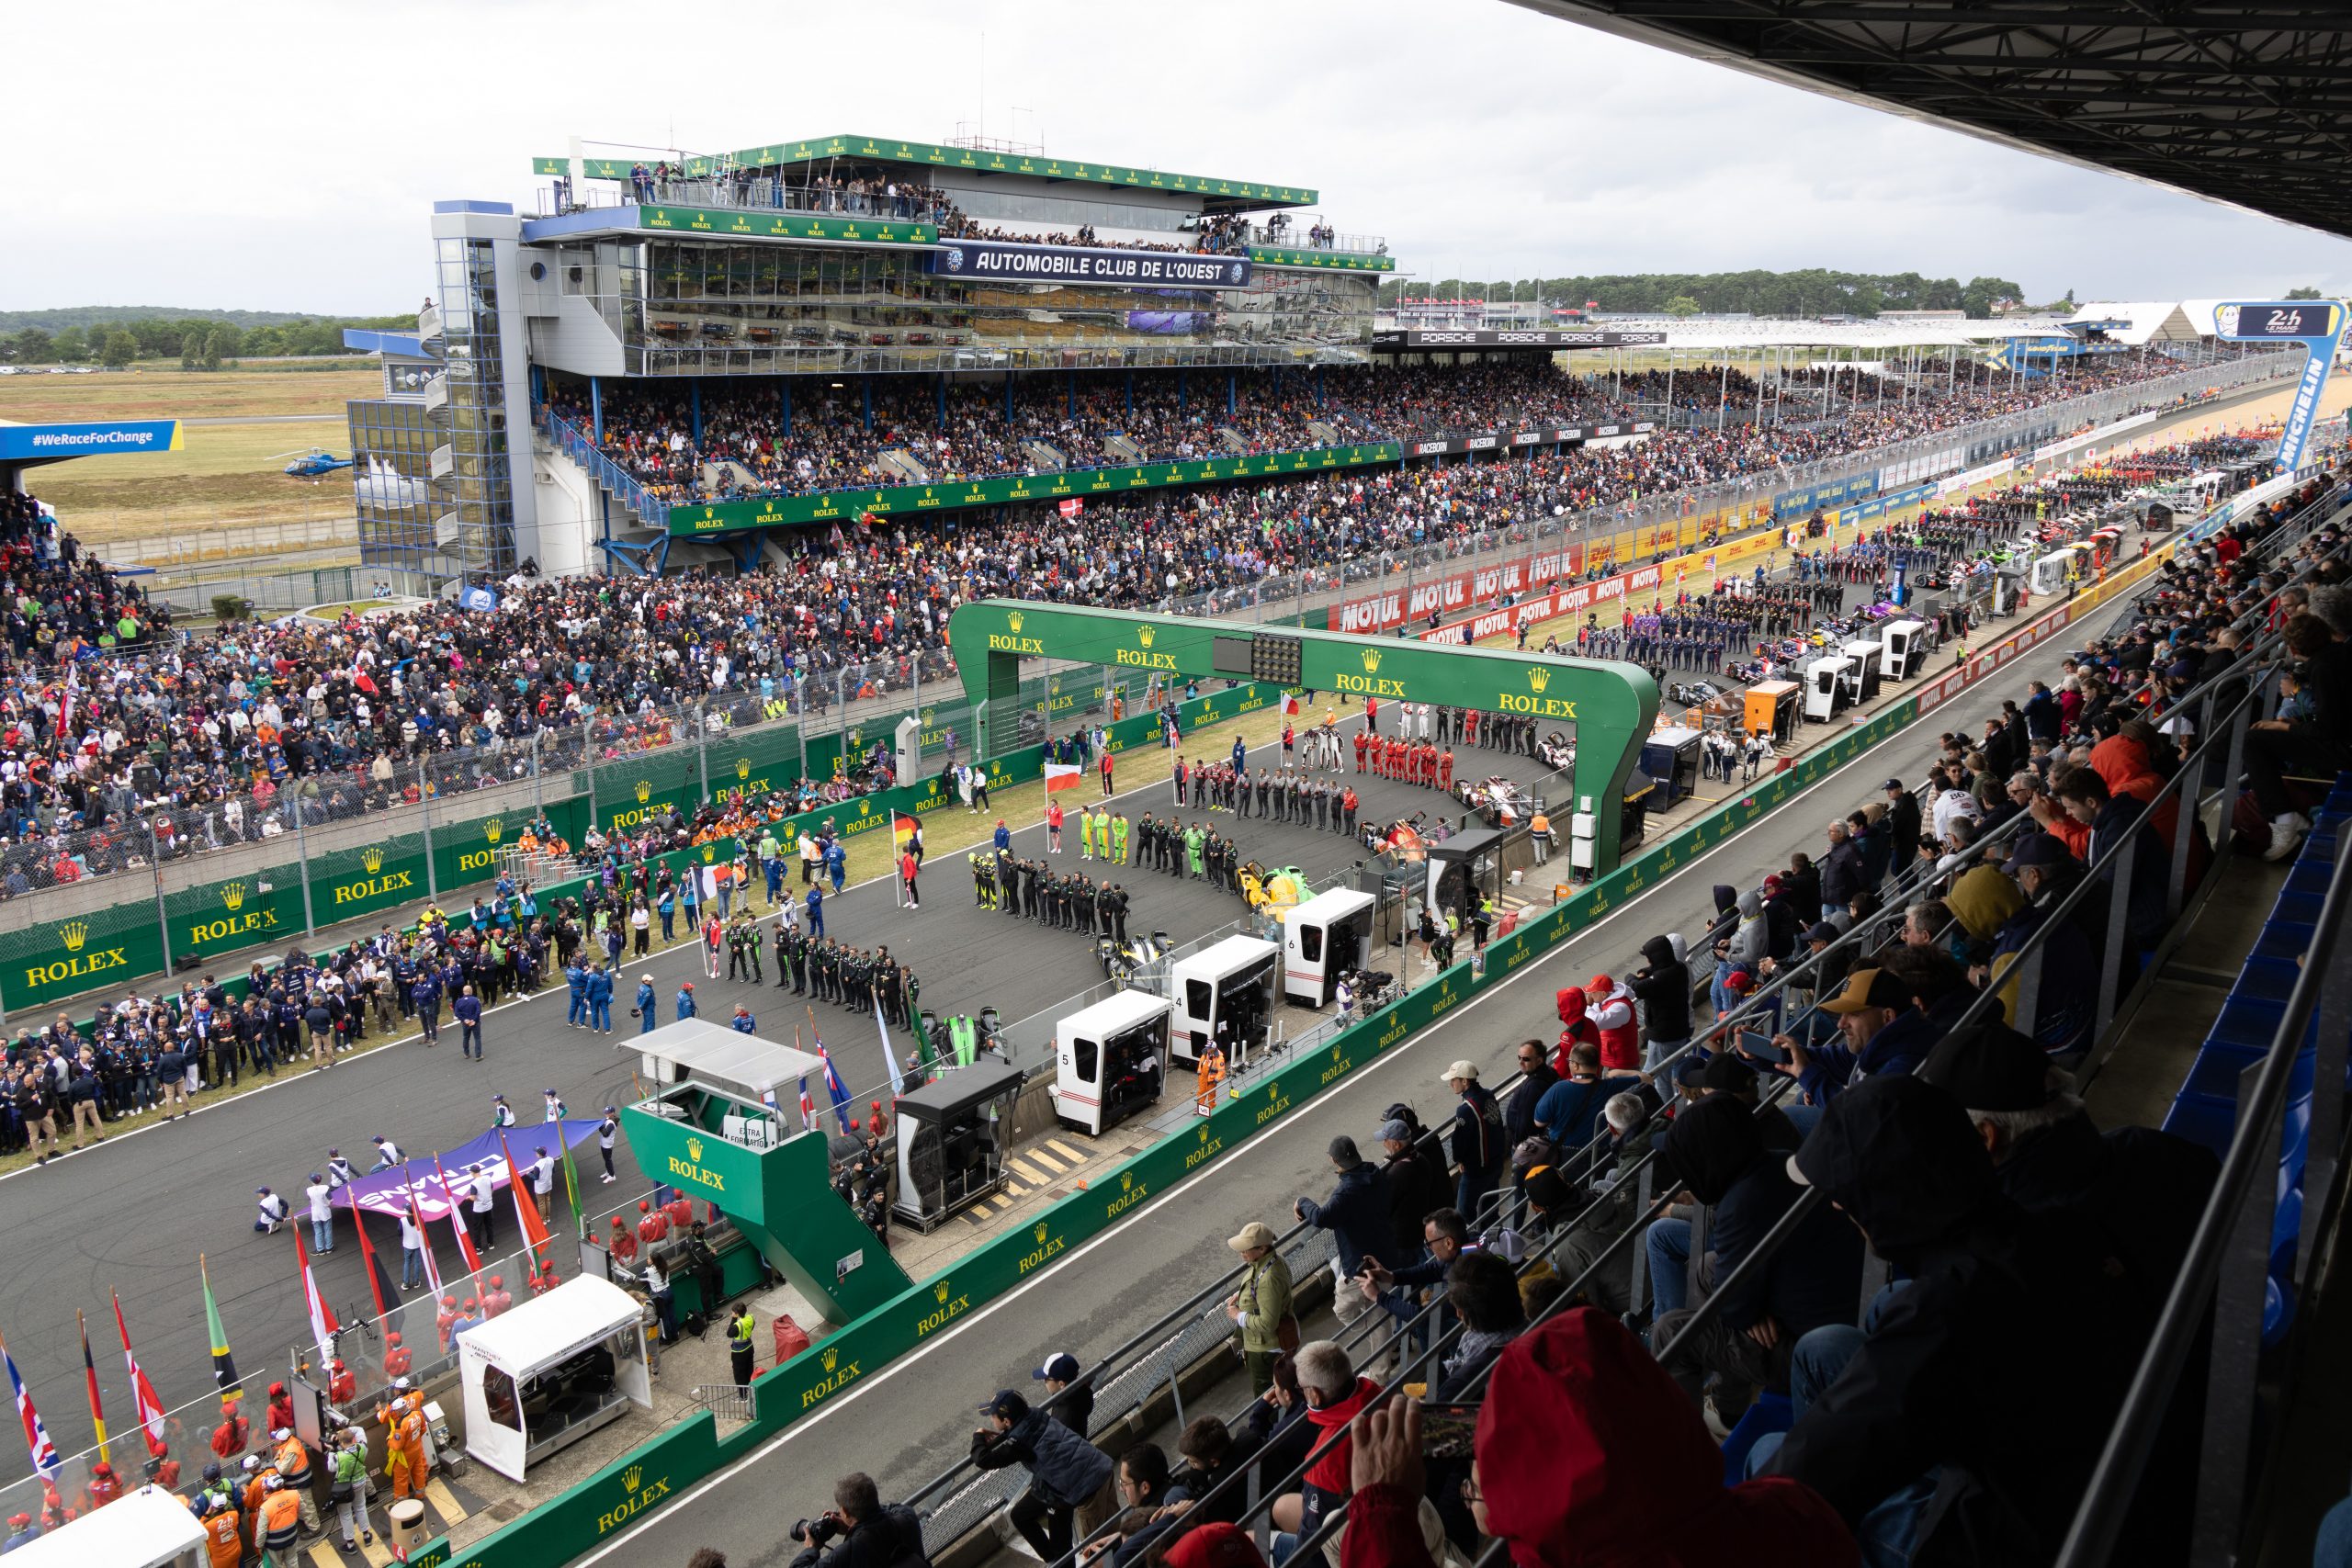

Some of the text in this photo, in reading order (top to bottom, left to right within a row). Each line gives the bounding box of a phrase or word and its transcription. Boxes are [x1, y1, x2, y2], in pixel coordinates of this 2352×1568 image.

[976, 252, 1090, 276] AUTOMOBILE
[1095, 259, 1136, 277] CLUB
[1141, 261, 1161, 277] DE
[1166, 263, 1224, 280] L'OUEST
[1421, 333, 1476, 342] PORSCHE
[1498, 333, 1545, 342] PORSCHE
[1561, 334, 1603, 342] PORSCHE
[2280, 358, 2324, 465] MICHELIN
[1516, 433, 1540, 444] RACEBORN
[1559, 429, 1581, 440] RACEBORN
[1599, 426, 1619, 436] RACEBORN
[33, 439, 153, 457] #WeRaceForChange
[1419, 441, 1447, 454] RACEBORN
[1470, 437, 1496, 449] RACEBORN
[868, 503, 890, 512] ROLEX
[918, 499, 940, 507] ROLEX
[965, 494, 985, 502] ROLEX
[757, 514, 782, 523] ROLEX
[814, 508, 839, 517] ROLEX
[695, 520, 724, 529] ROLEX
[1529, 553, 1571, 583] MOTUL
[1473, 566, 1520, 599] MOTUL
[1597, 579, 1625, 599] MOTUL
[1410, 581, 1464, 615] MOTUL
[1558, 588, 1589, 610] MOTUL
[1341, 595, 1400, 631] MOTUL
[1519, 601, 1551, 622] MOTUL
[1474, 612, 1510, 635] MOTUL
[989, 634, 1044, 654] ROLEX
[1117, 649, 1176, 669] ROLEX
[1336, 673, 1406, 697] ROLEX
[1945, 672, 1963, 696] MOTUL
[1240, 698, 1262, 711] ROLEX
[1499, 691, 1577, 719] ROLEX
[1920, 685, 1940, 713] MOTUL
[1195, 711, 1219, 726] ROLEX
[716, 779, 771, 804] RLEX
[1950, 791, 1965, 800] 86
[846, 814, 884, 834] ROLEX
[335, 871, 412, 904] ROLEX
[1626, 878, 1643, 895] ROLEX
[1589, 898, 1609, 918] ROLEX
[190, 908, 279, 944] ROLEX
[1551, 922, 1570, 942] ROLEX
[1289, 940, 1294, 949] 6
[26, 947, 128, 987] ROLEX
[1509, 946, 1529, 968] ROLEX
[1176, 998, 1182, 1007] 4
[1432, 992, 1457, 1015] ROLEX
[1380, 1021, 1407, 1049] ROLEX
[1063, 1054, 1068, 1065] 5
[1321, 1058, 1351, 1086] ROLEX
[1257, 1095, 1290, 1124] ROLEX
[1185, 1135, 1222, 1168] ROLEX
[669, 1157, 725, 1192] ROLEX
[1107, 1183, 1148, 1218] ROLEX
[1019, 1235, 1065, 1274] ROLEX
[917, 1293, 970, 1337] ROLEX
[802, 1359, 862, 1409] ROLEX
[598, 1475, 671, 1535] ROLEX
[397, 1547, 404, 1560] 4
